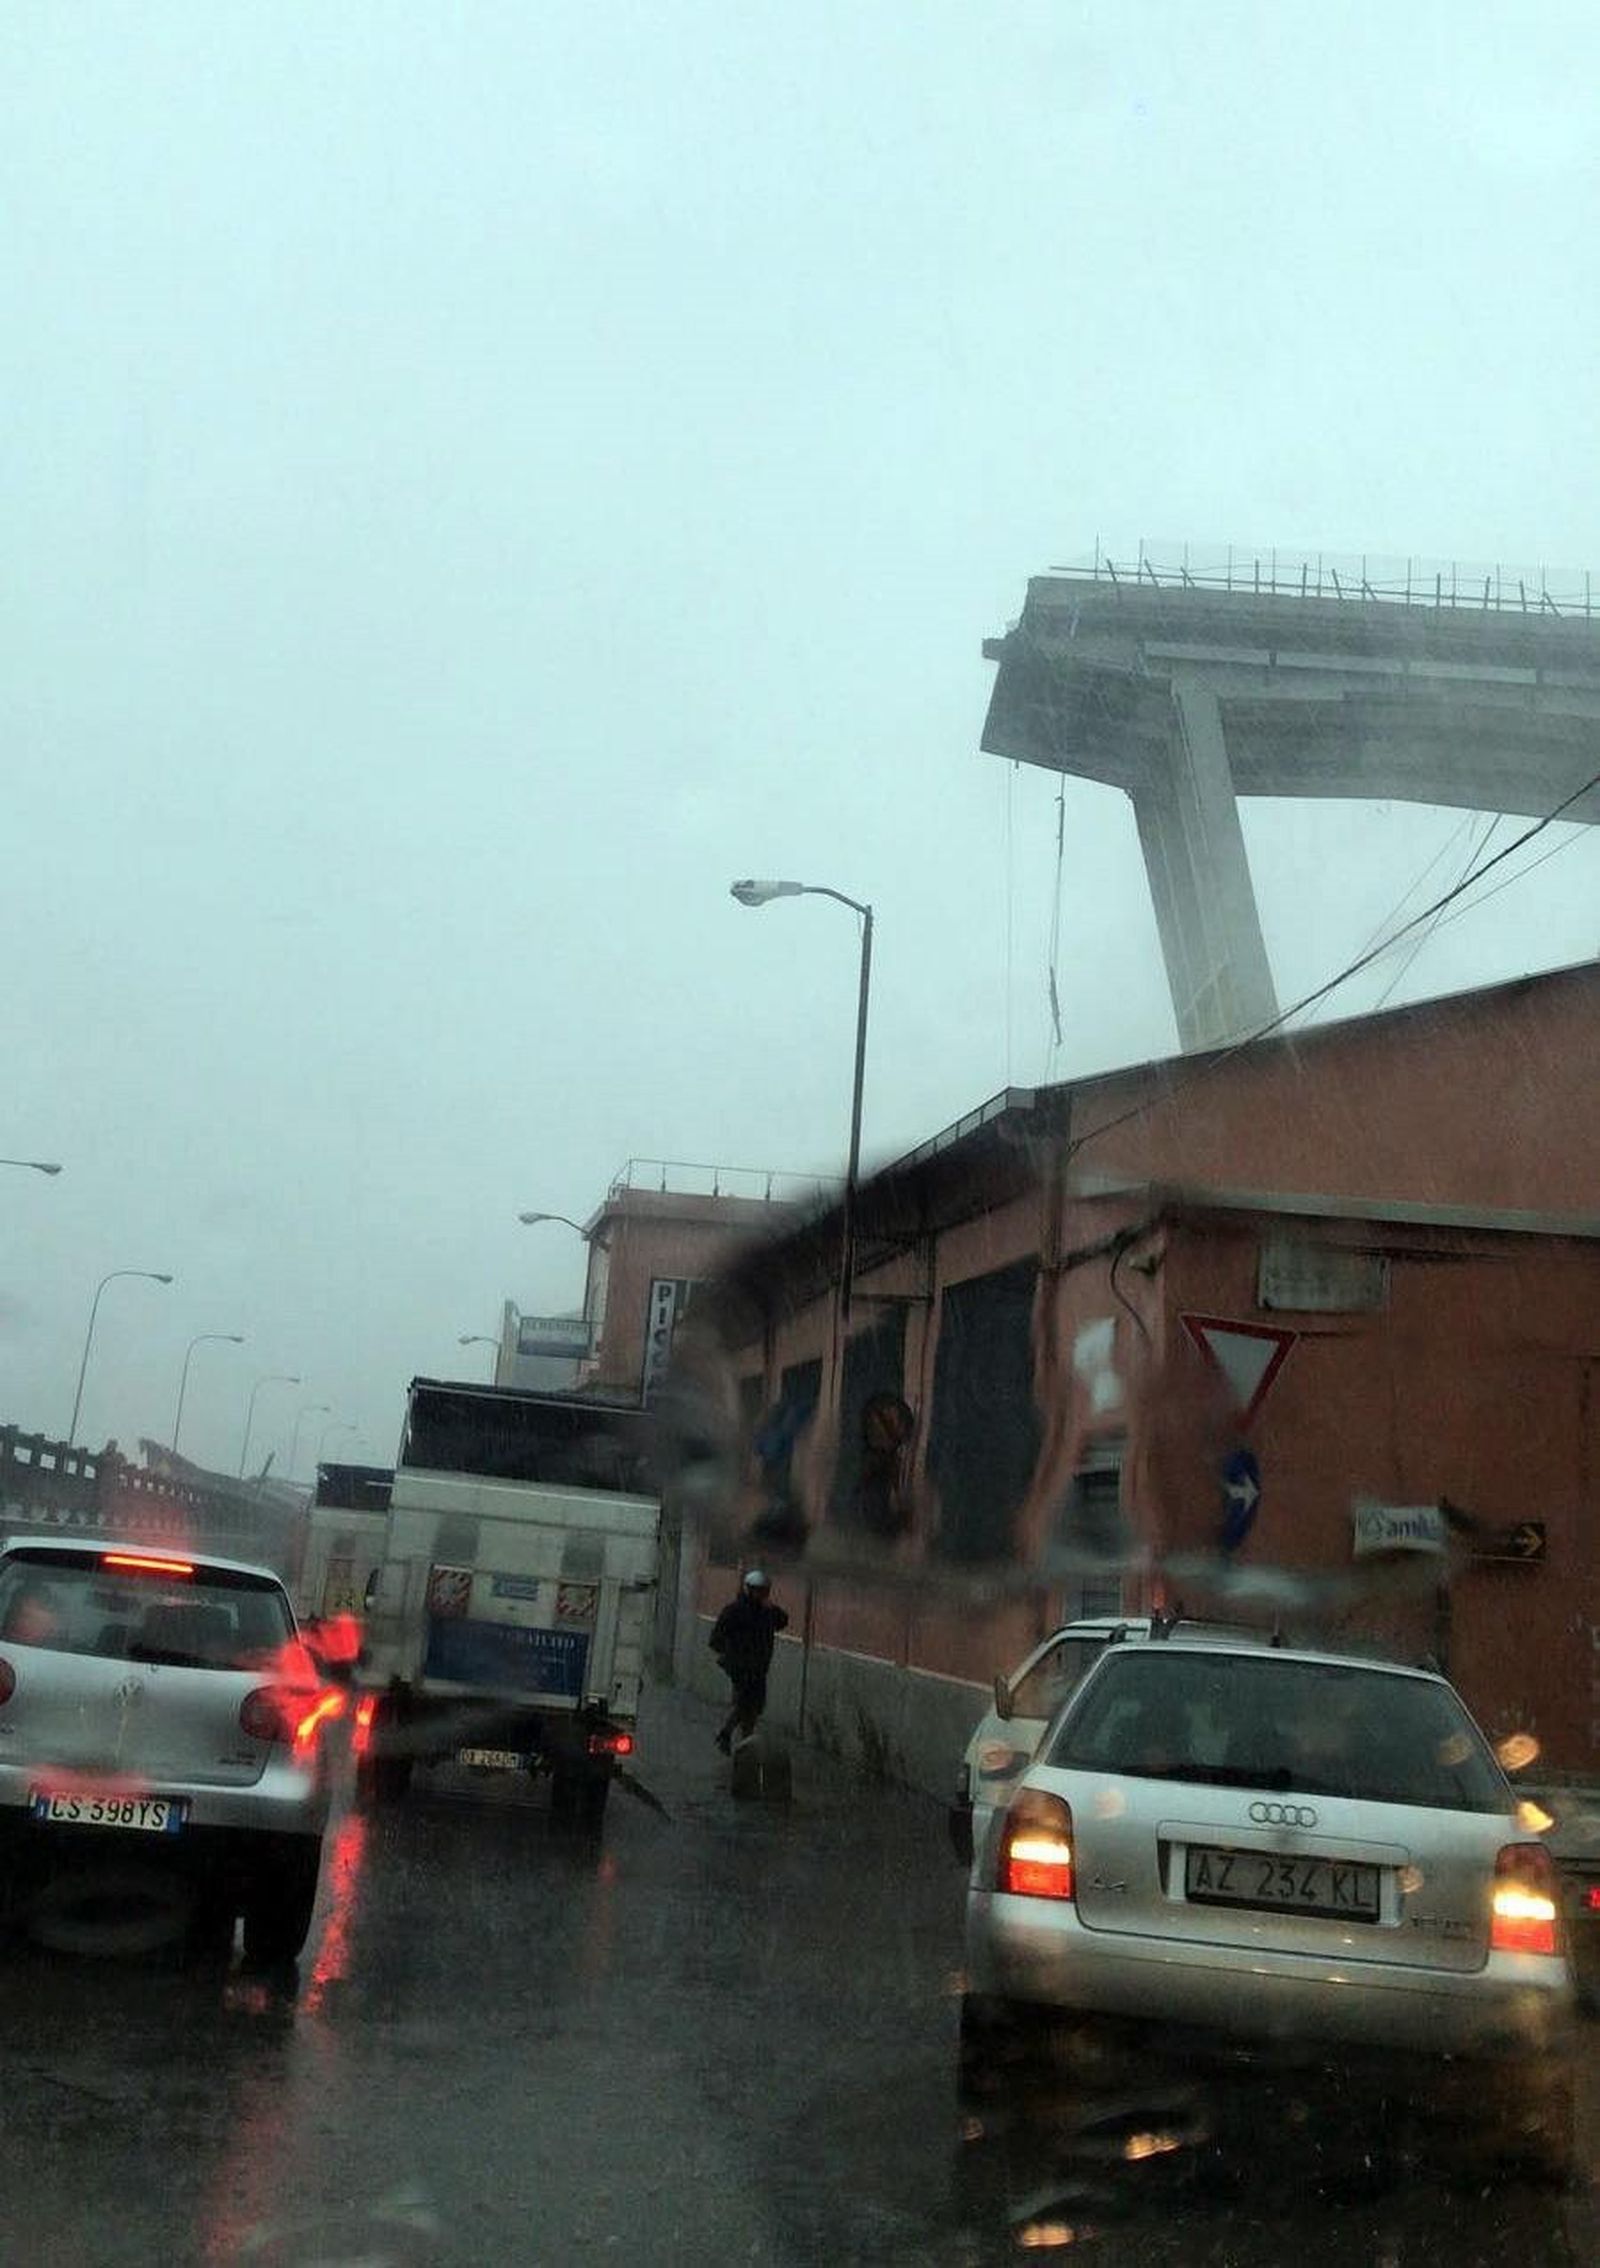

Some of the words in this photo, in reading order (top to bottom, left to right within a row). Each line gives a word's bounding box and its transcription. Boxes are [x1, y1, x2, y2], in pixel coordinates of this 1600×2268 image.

[52, 1795, 82, 1820] CS
[1195, 1853, 1235, 1892] AZ
[1256, 1860, 1317, 1902] 234
[1332, 1866, 1372, 1908] KL
